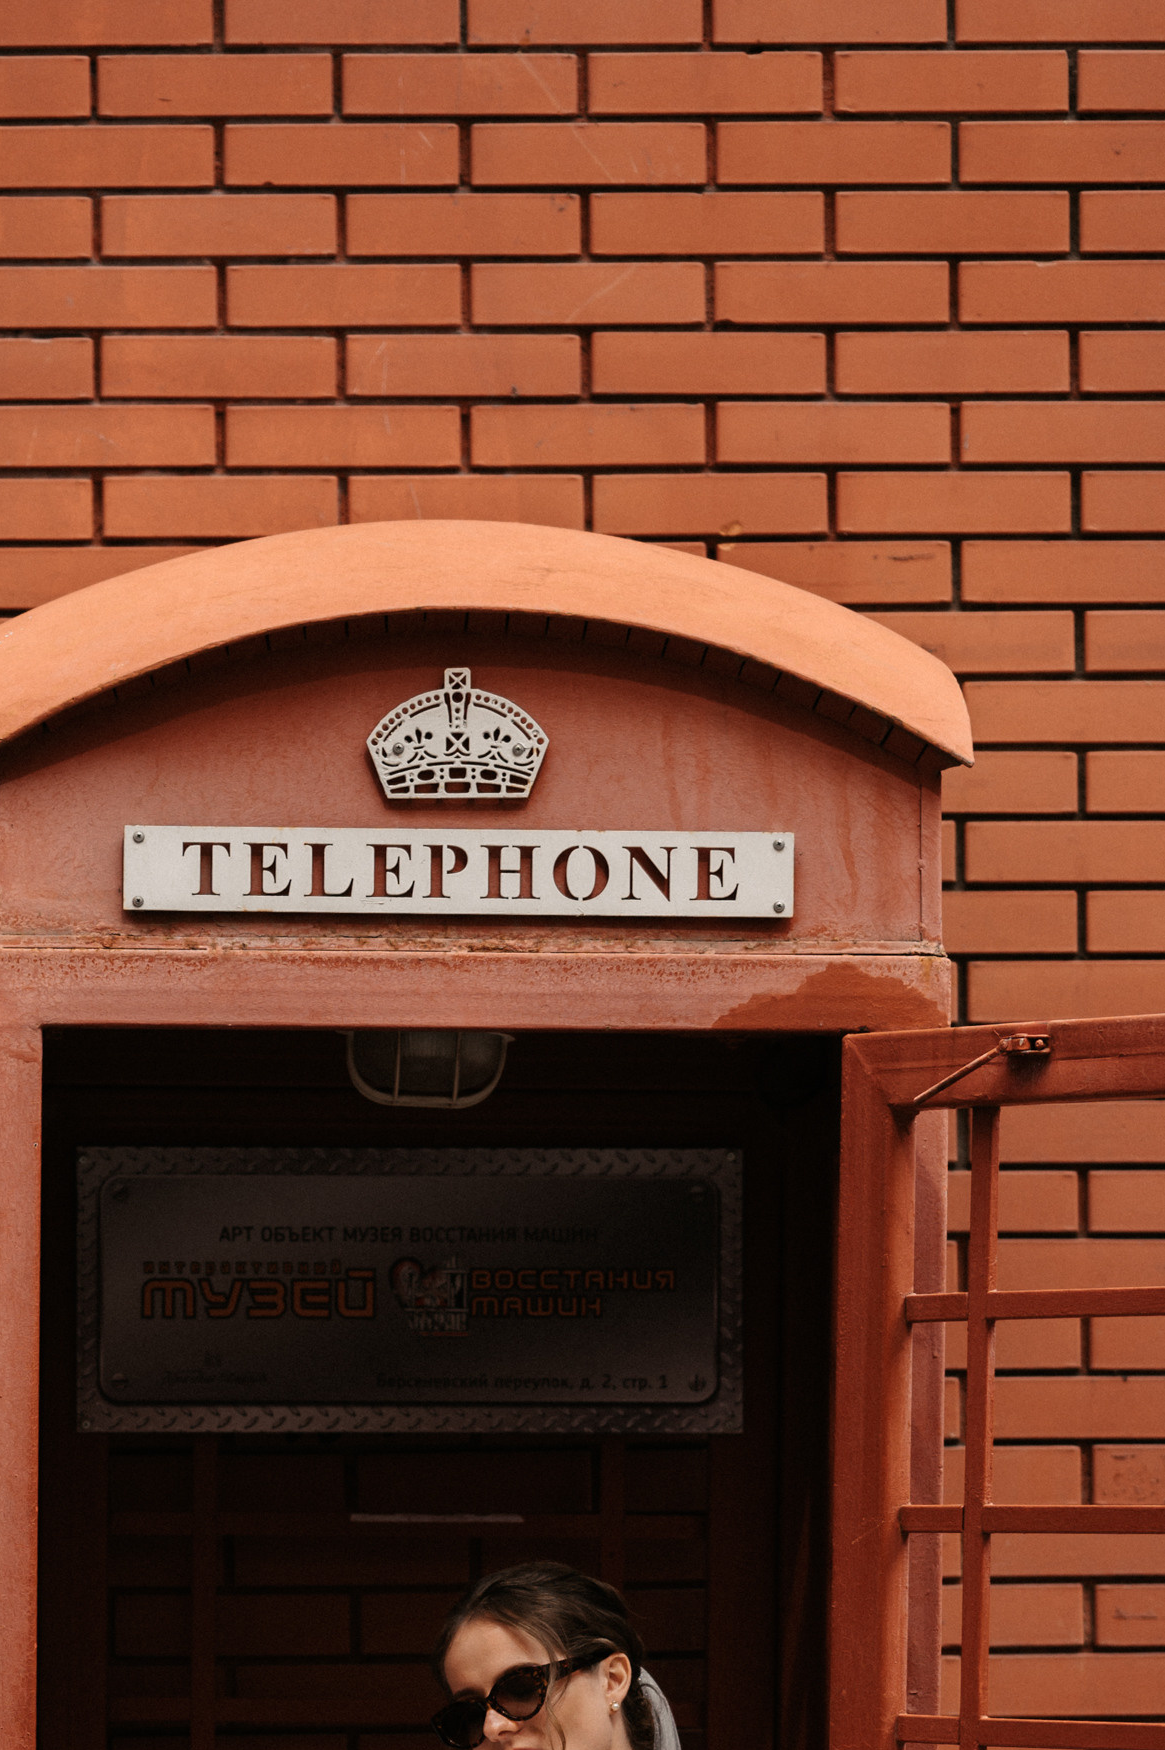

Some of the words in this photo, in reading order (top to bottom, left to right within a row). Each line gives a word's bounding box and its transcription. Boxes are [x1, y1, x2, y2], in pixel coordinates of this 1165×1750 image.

[182, 841, 739, 902] TELEPHONE
[219, 1226, 254, 1243] АРТ
[261, 1226, 336, 1243] ОБЪЕКТ
[343, 1226, 402, 1243] МУЗЕЯ
[409, 1226, 517, 1243] ВОССТАНИЯ
[523, 1226, 598, 1244] МАШИН
[471, 1268, 675, 1291] ВОССТАНИЯ
[494, 1377, 572, 1391] переулок,
[621, 1377, 652, 1391] стр.
[658, 1374, 668, 1388] 1
